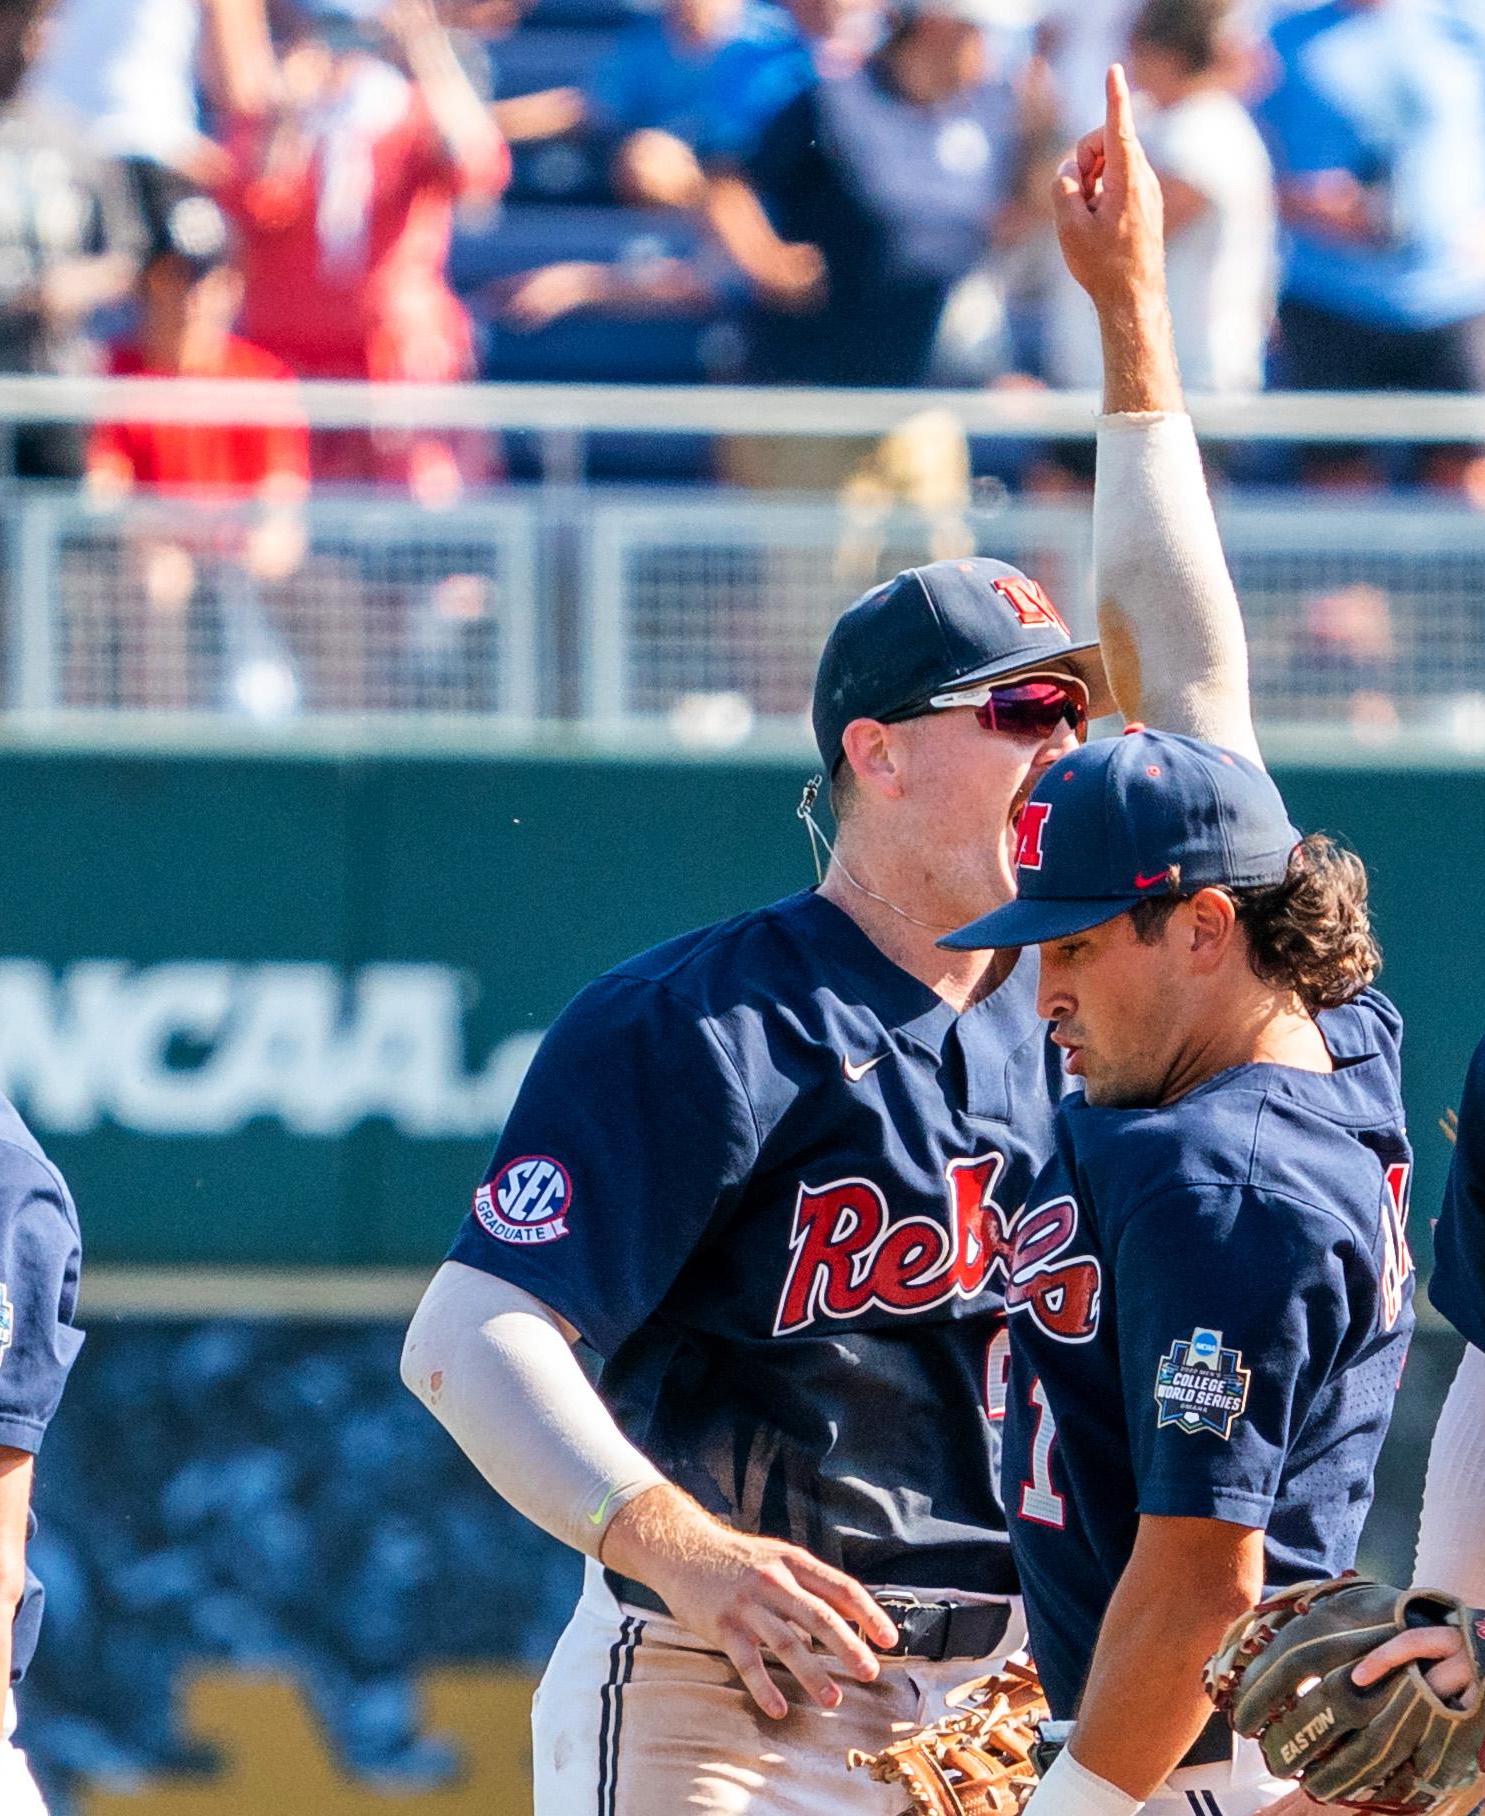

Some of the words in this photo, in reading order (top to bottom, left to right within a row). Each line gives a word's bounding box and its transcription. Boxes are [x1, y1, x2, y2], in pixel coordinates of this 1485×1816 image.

[498, 1160, 565, 1221] SEC
[477, 1200, 546, 1241] GRADUATE
[1157, 1384, 1196, 1403] WORLD
[1195, 1390, 1242, 1411] SERIES
[1172, 1372, 1227, 1394] COLLEGE
[1281, 1706, 1335, 1765] EASTON
